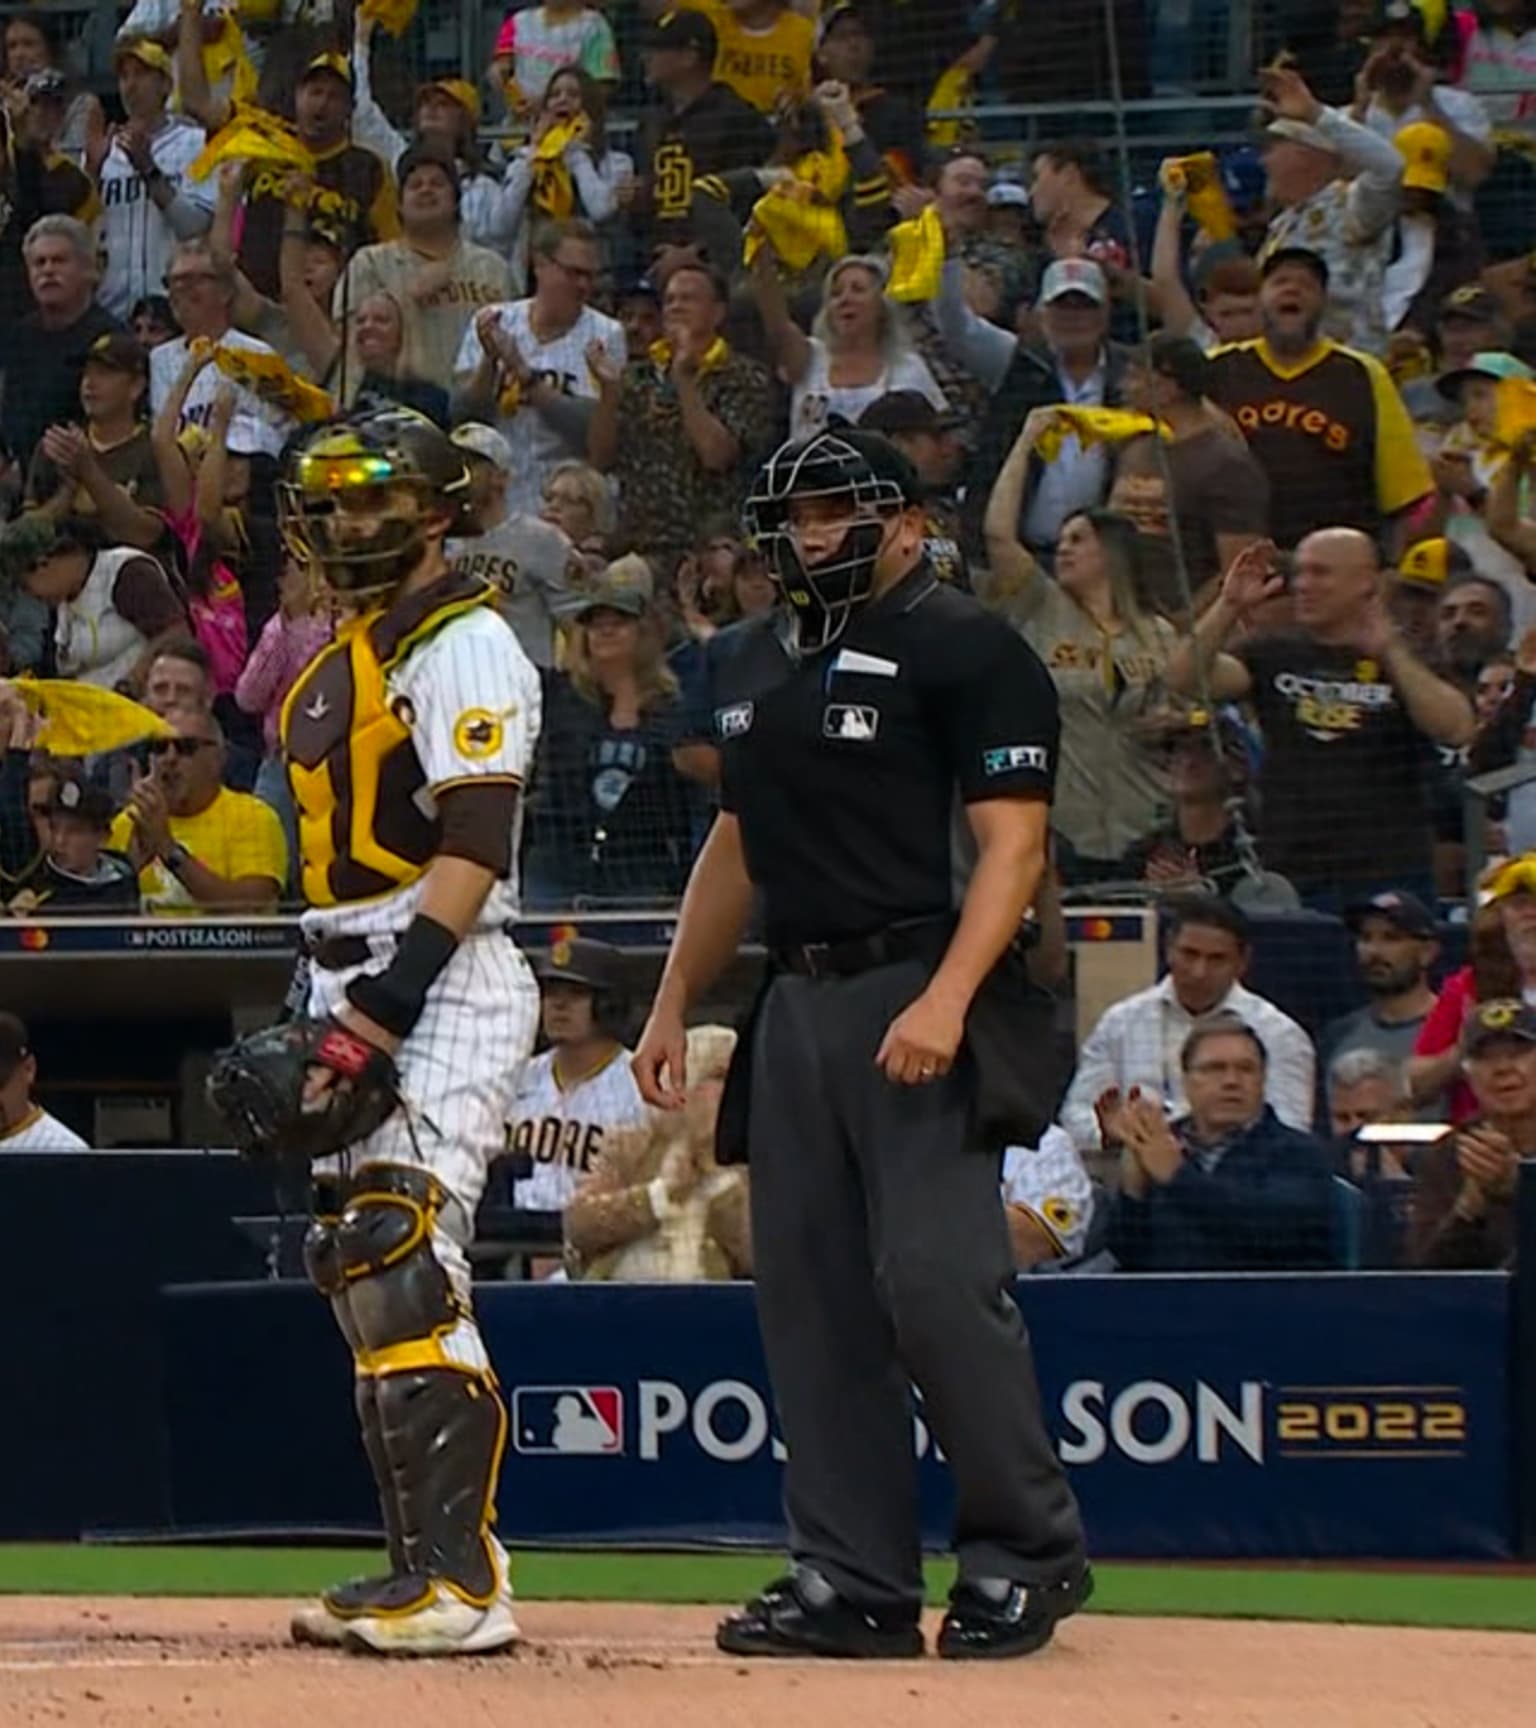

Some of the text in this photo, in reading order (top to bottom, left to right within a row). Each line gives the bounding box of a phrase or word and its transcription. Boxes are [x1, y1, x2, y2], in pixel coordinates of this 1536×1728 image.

[1237, 401, 1348, 450] adres
[146, 928, 253, 946] POSTSEASON
[503, 1116, 605, 1172] ADRE
[638, 1378, 1464, 1465] POSON 2022
